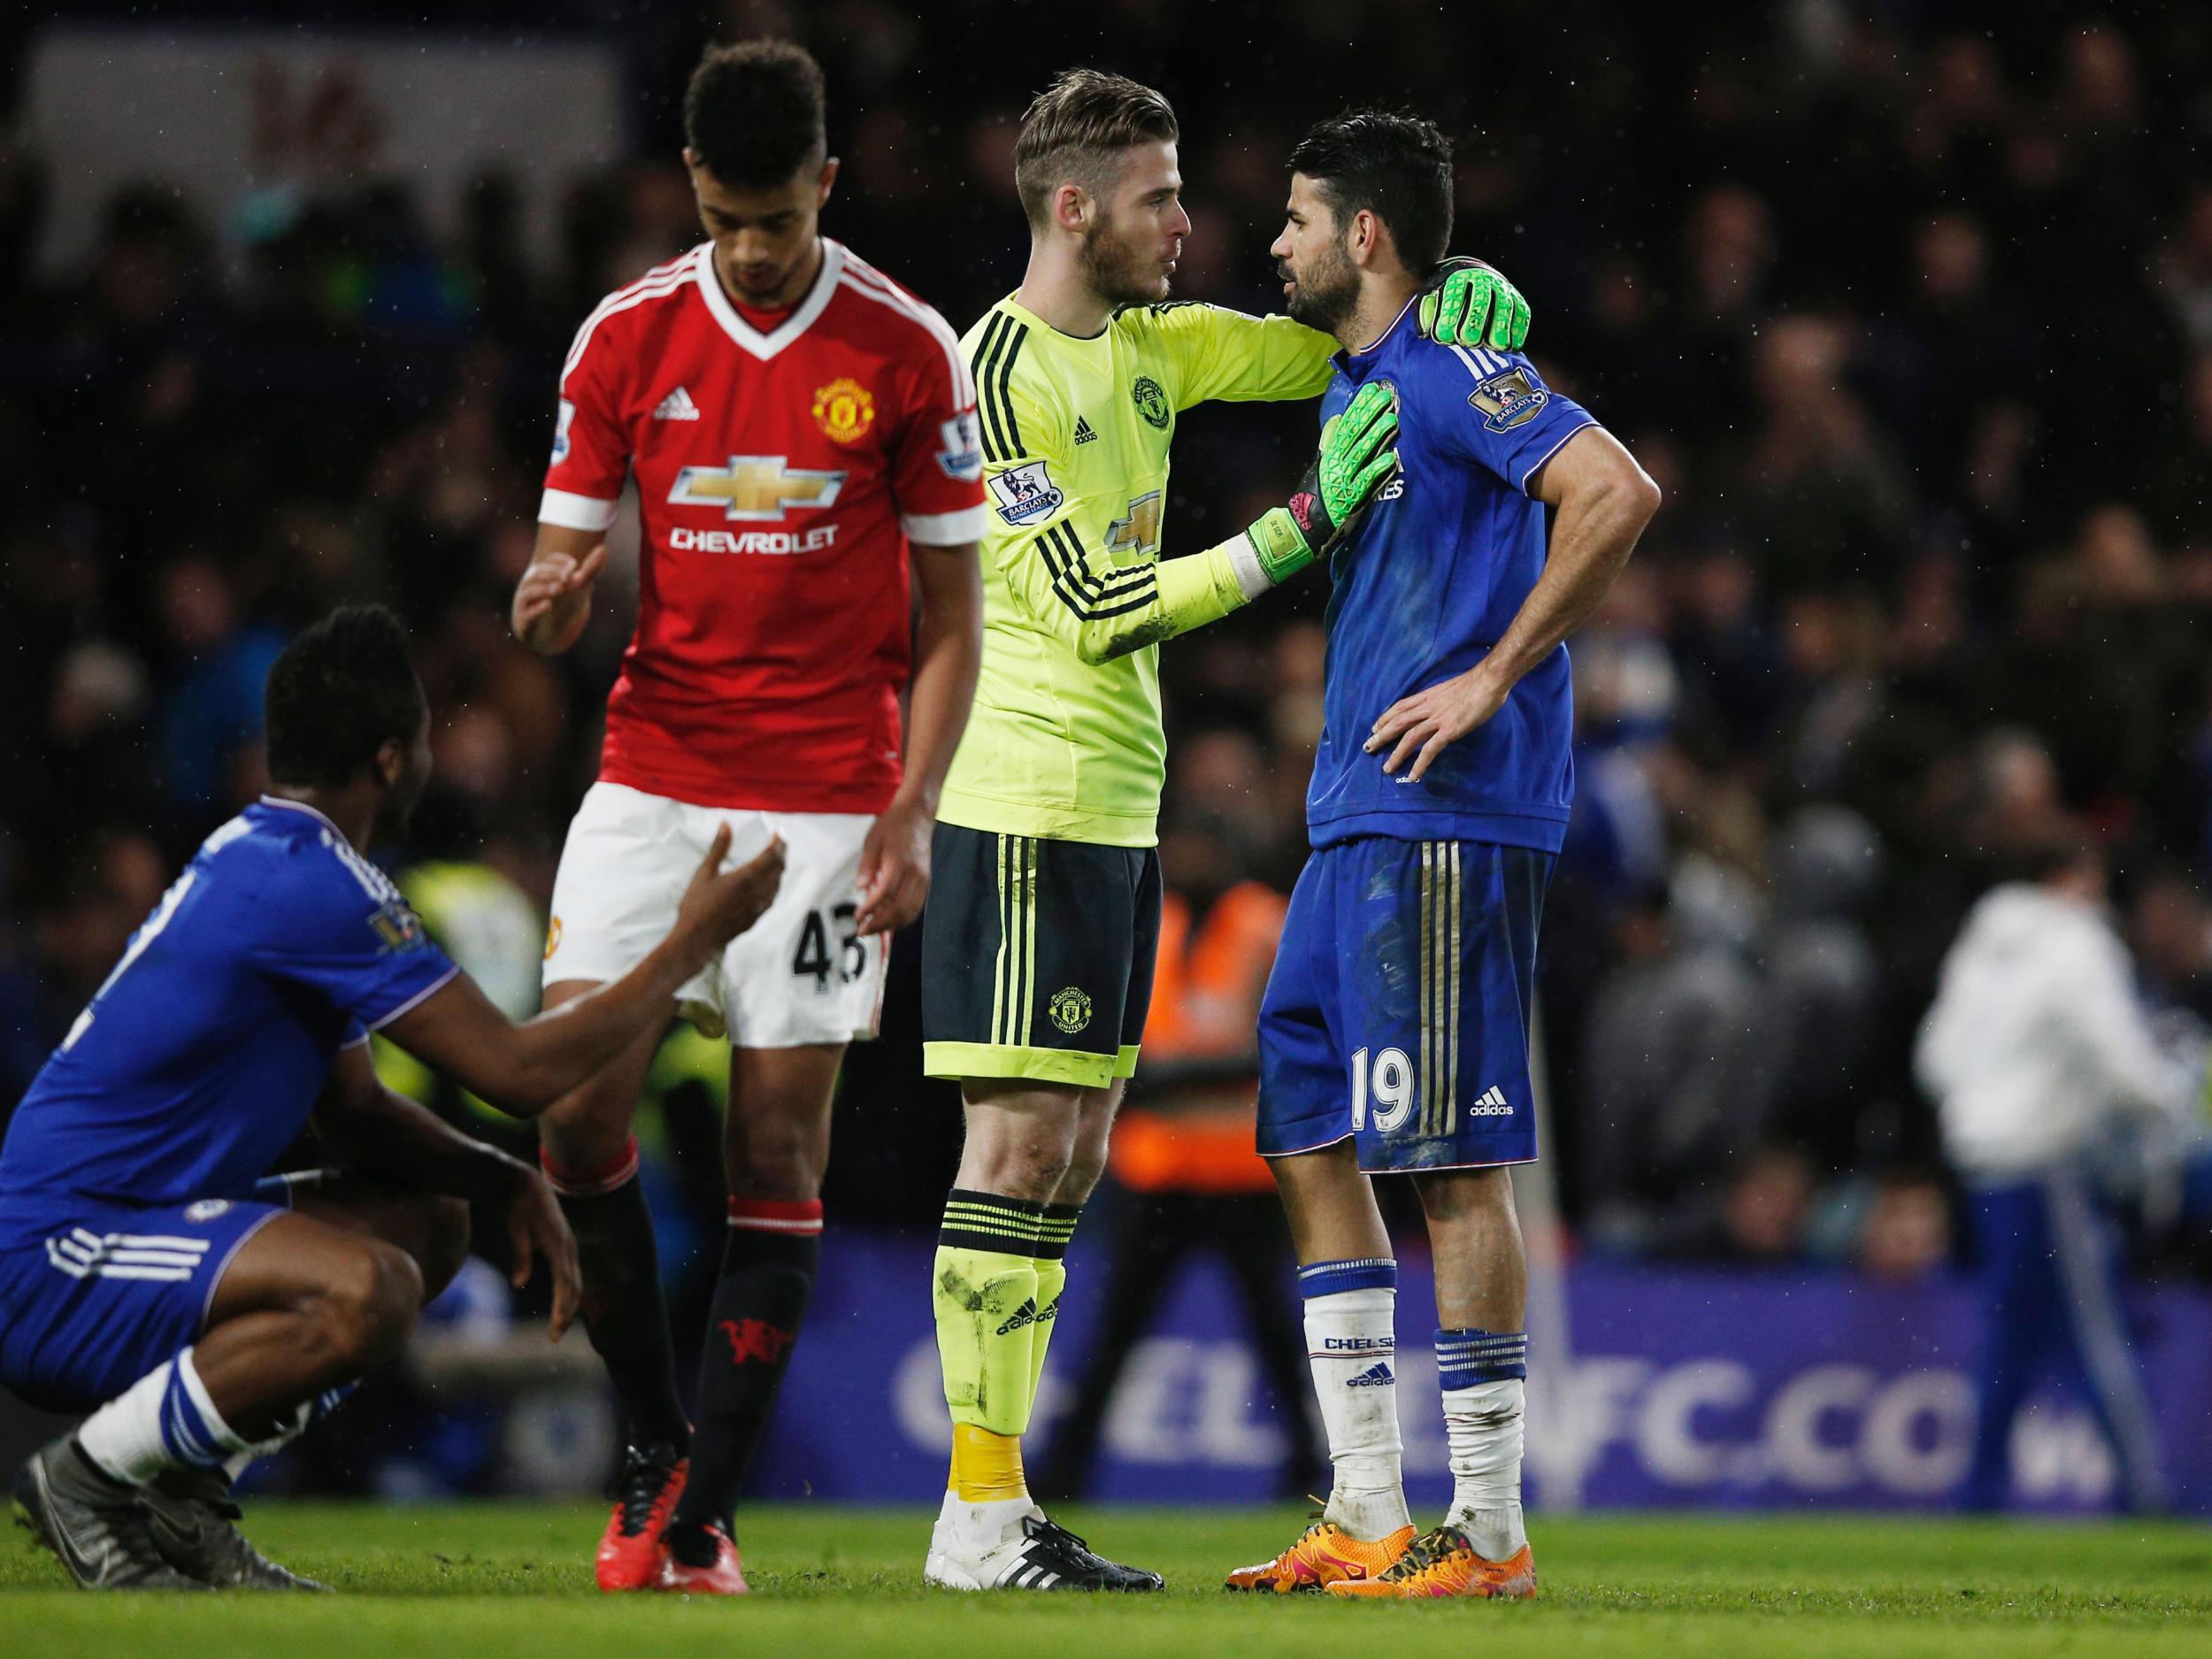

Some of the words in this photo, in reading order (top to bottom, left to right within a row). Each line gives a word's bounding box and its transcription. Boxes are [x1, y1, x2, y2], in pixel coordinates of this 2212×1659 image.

[1495, 397, 1532, 424] BARCLAYS
[1074, 431, 1098, 446] adidas
[1008, 496, 1048, 516] BARCLAYS
[669, 524, 840, 555] CHEVROLET
[792, 901, 869, 995] 43
[1055, 990, 1087, 1005] MANCHESTER
[1351, 1047, 1415, 1133] 19
[1470, 1103, 1515, 1116] adidas
